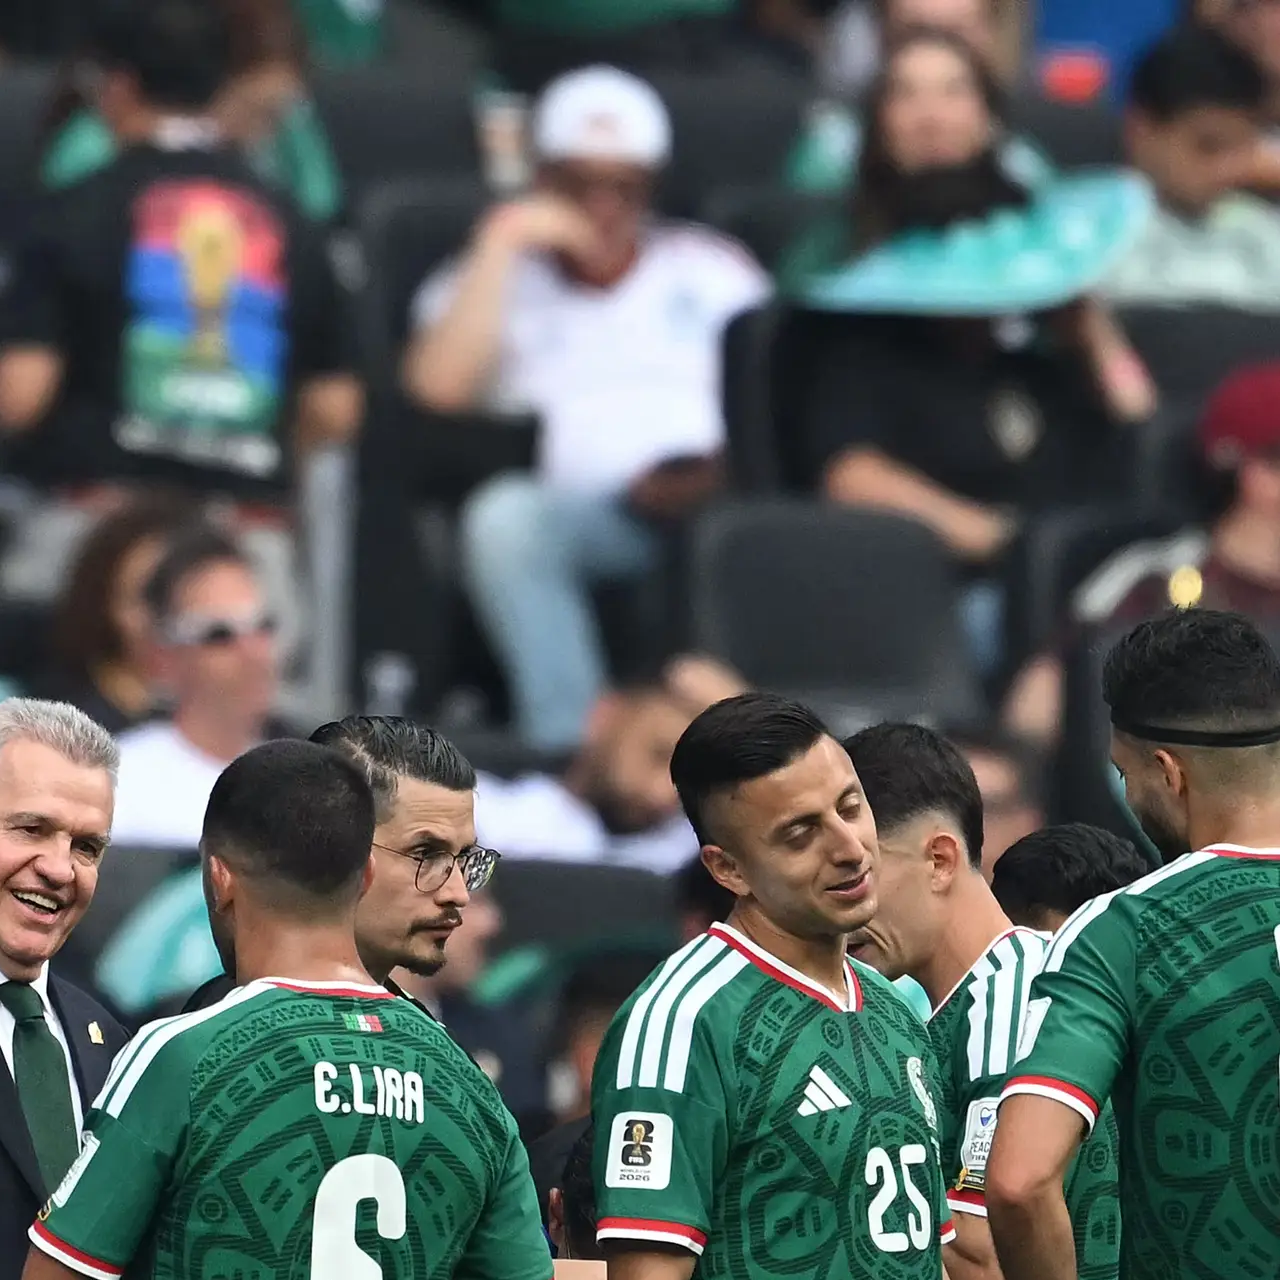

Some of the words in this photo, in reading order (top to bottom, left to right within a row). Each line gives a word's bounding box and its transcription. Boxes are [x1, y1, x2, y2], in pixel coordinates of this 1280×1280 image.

[314, 1061, 424, 1123] E.LIRA
[971, 1141, 990, 1153] PEAC
[865, 1144, 931, 1252] 25
